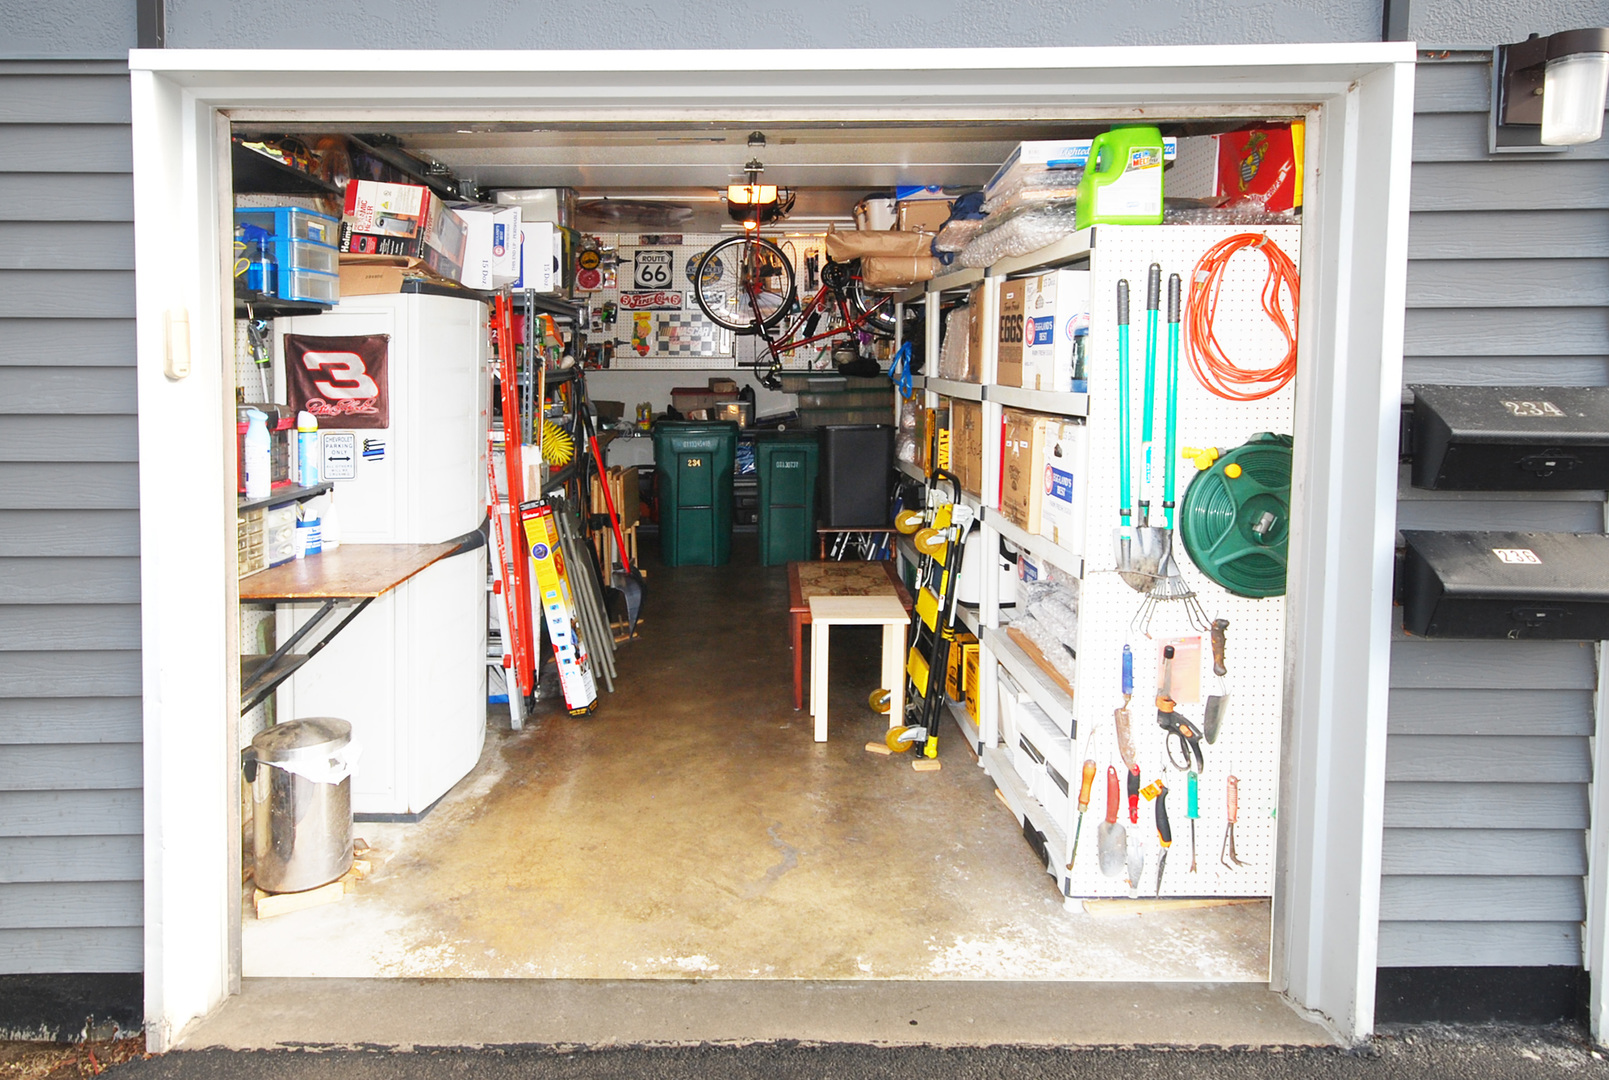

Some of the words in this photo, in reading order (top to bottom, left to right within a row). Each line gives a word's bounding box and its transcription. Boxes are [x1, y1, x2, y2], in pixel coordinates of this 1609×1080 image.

[1132, 156, 1150, 166] MELT
[357, 200, 368, 231] CAMIC
[642, 265, 666, 282] 66
[676, 326, 711, 336] NASCAR
[1000, 314, 1024, 343] EGGS
[1038, 332, 1048, 341] BEST
[302, 350, 380, 400] 3
[1505, 402, 1564, 416] 234
[938, 428, 950, 478] EWALT
[1498, 550, 1536, 562] 236
